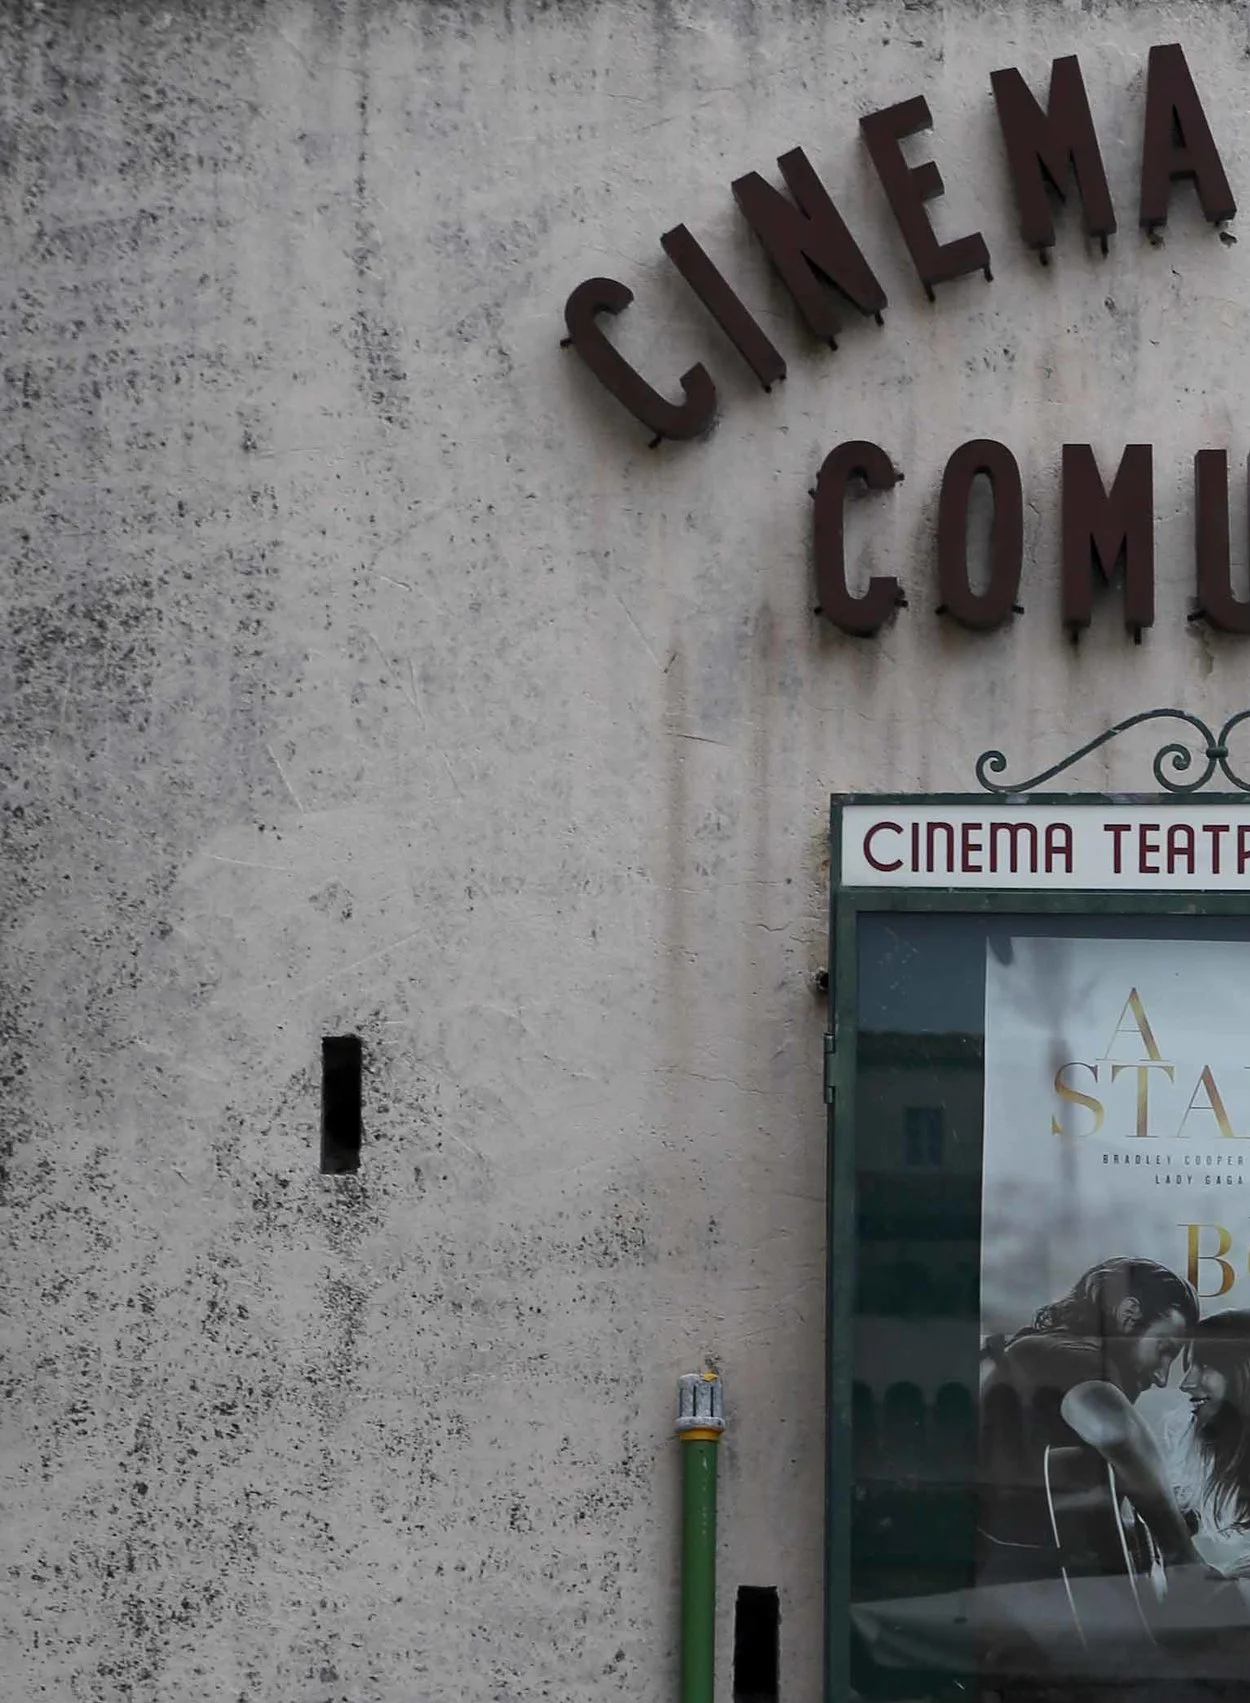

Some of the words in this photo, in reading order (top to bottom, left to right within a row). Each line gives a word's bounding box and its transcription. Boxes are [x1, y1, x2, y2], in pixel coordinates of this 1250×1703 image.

[561, 42, 1237, 443] CINEMA
[863, 821, 1073, 873] CINEMA
[1096, 986, 1170, 1061] A
[1103, 1154, 1171, 1165] BRADLEY
[1184, 1155, 1244, 1166] COOPER
[1155, 1174, 1192, 1185] LADY
[1205, 1175, 1243, 1185] GAGA
